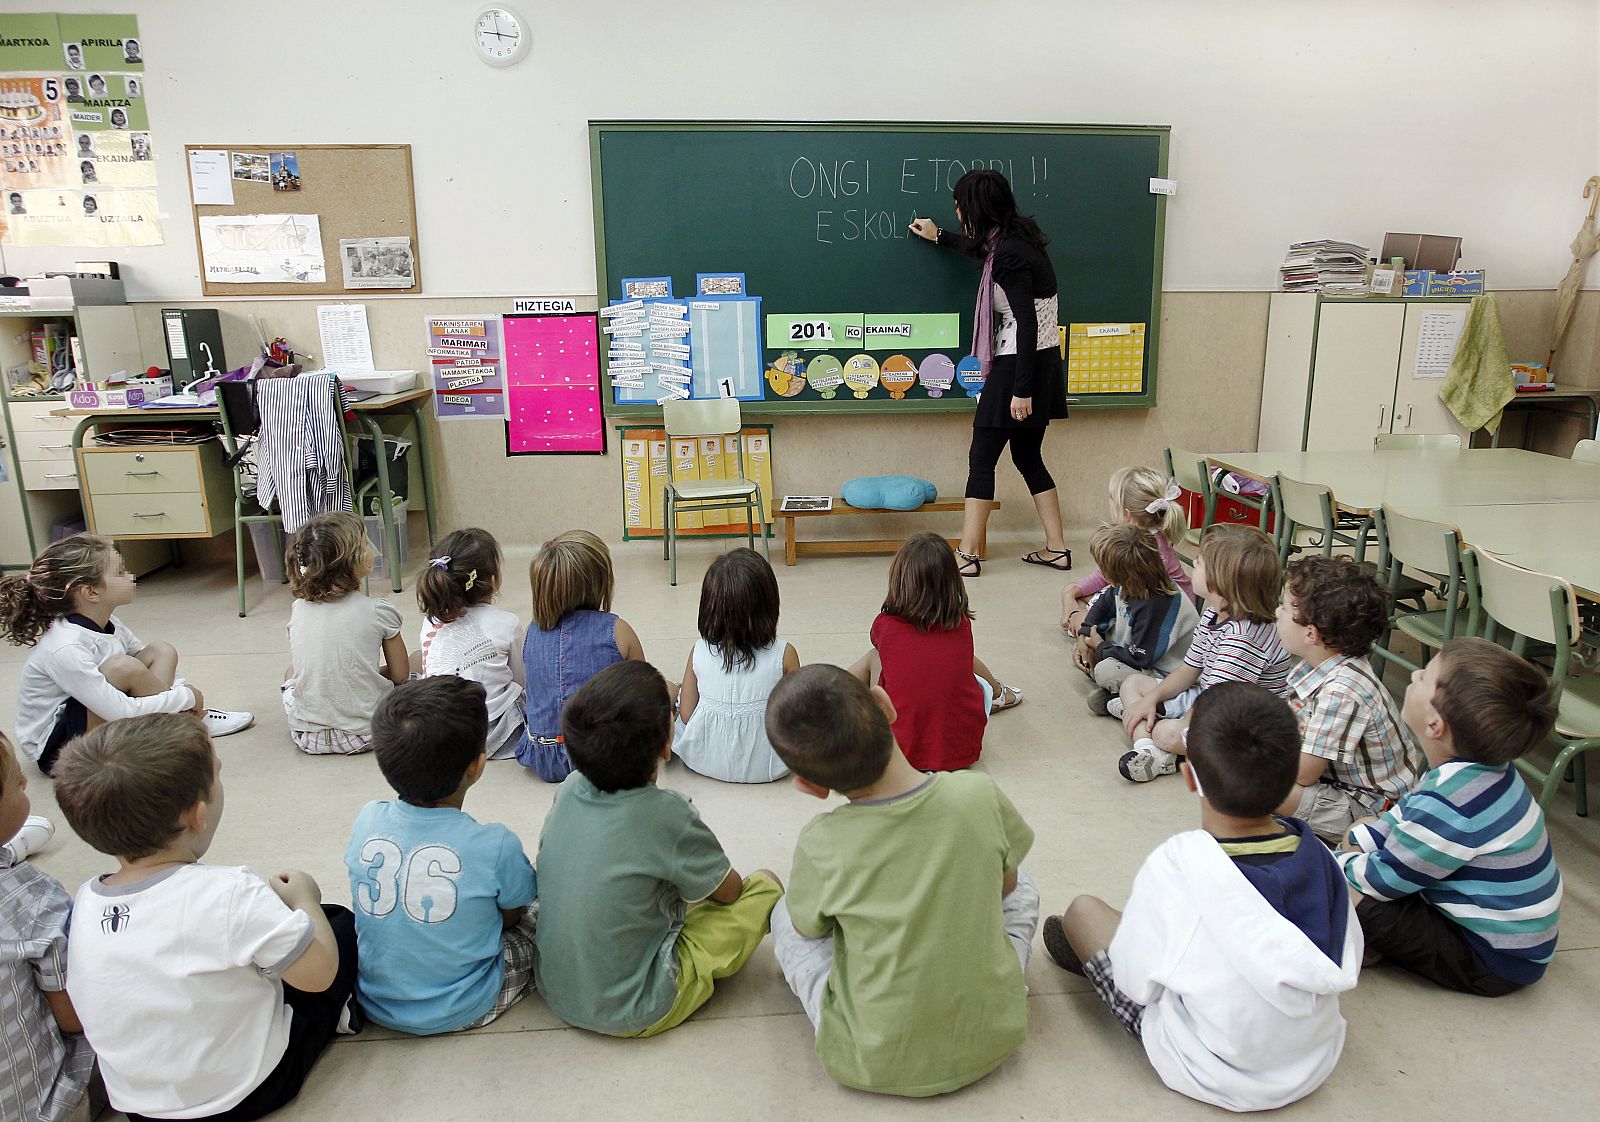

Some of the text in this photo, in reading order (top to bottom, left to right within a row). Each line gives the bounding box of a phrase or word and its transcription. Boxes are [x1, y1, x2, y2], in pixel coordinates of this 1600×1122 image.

[0, 38, 50, 47] MARTXOA
[81, 38, 123, 47] APIRILA
[46, 79, 58, 100] 5
[84, 99, 132, 108] MAIATZA
[96, 155, 136, 163] EKAINA
[790, 156, 869, 198] ONGI
[516, 301, 573, 311] HIZTEGIA
[791, 322, 831, 339] 201
[441, 338, 486, 348] MARIMAR
[442, 368, 494, 376] HAMAIKETAKOA
[450, 376, 482, 388] PLASTIKA
[722, 379, 731, 396] 1
[73, 393, 97, 406] Copy
[128, 390, 144, 402] Copy
[356, 838, 462, 924] 36
